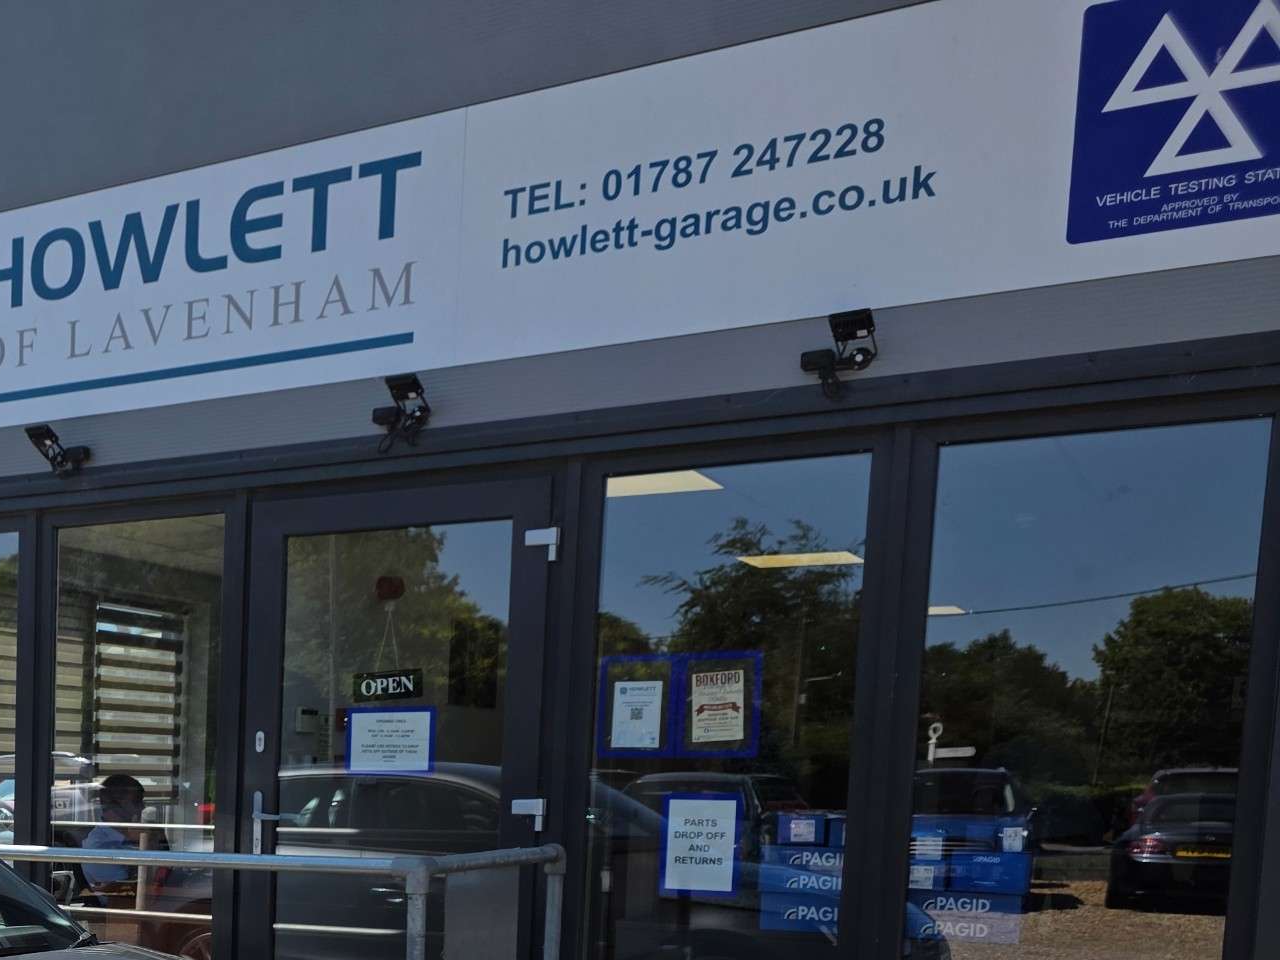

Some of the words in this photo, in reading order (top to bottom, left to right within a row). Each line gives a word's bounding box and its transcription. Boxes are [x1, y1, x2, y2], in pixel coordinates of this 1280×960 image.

[504, 179, 587, 219] TEL:
[602, 149, 718, 201] 01787
[731, 118, 885, 178] 247228
[1095, 186, 1161, 207] VEHICLE
[1168, 173, 1237, 196] TESTING
[1161, 196, 1218, 212] APPROVED
[1223, 192, 1240, 203] BY
[502, 165, 937, 269] howlett-garage.co.uk
[1108, 217, 1128, 230] THE
[1133, 206, 1202, 226] DEPARTMENT
[1207, 205, 1223, 215] OF
[1228, 196, 1280, 211] TRANSPO
[67, 261, 418, 359] LAVENHAM
[360, 675, 414, 696] OPEN
[683, 818, 718, 828] PARTS
[673, 830, 704, 840] DROP
[705, 831, 728, 841] OFF
[688, 843, 711, 853] AND
[673, 855, 724, 867] RETURNS
[802, 851, 844, 866] PAGI
[798, 905, 839, 921] PAGI
[935, 896, 991, 913] PAGID
[933, 921, 988, 938] PAGID
